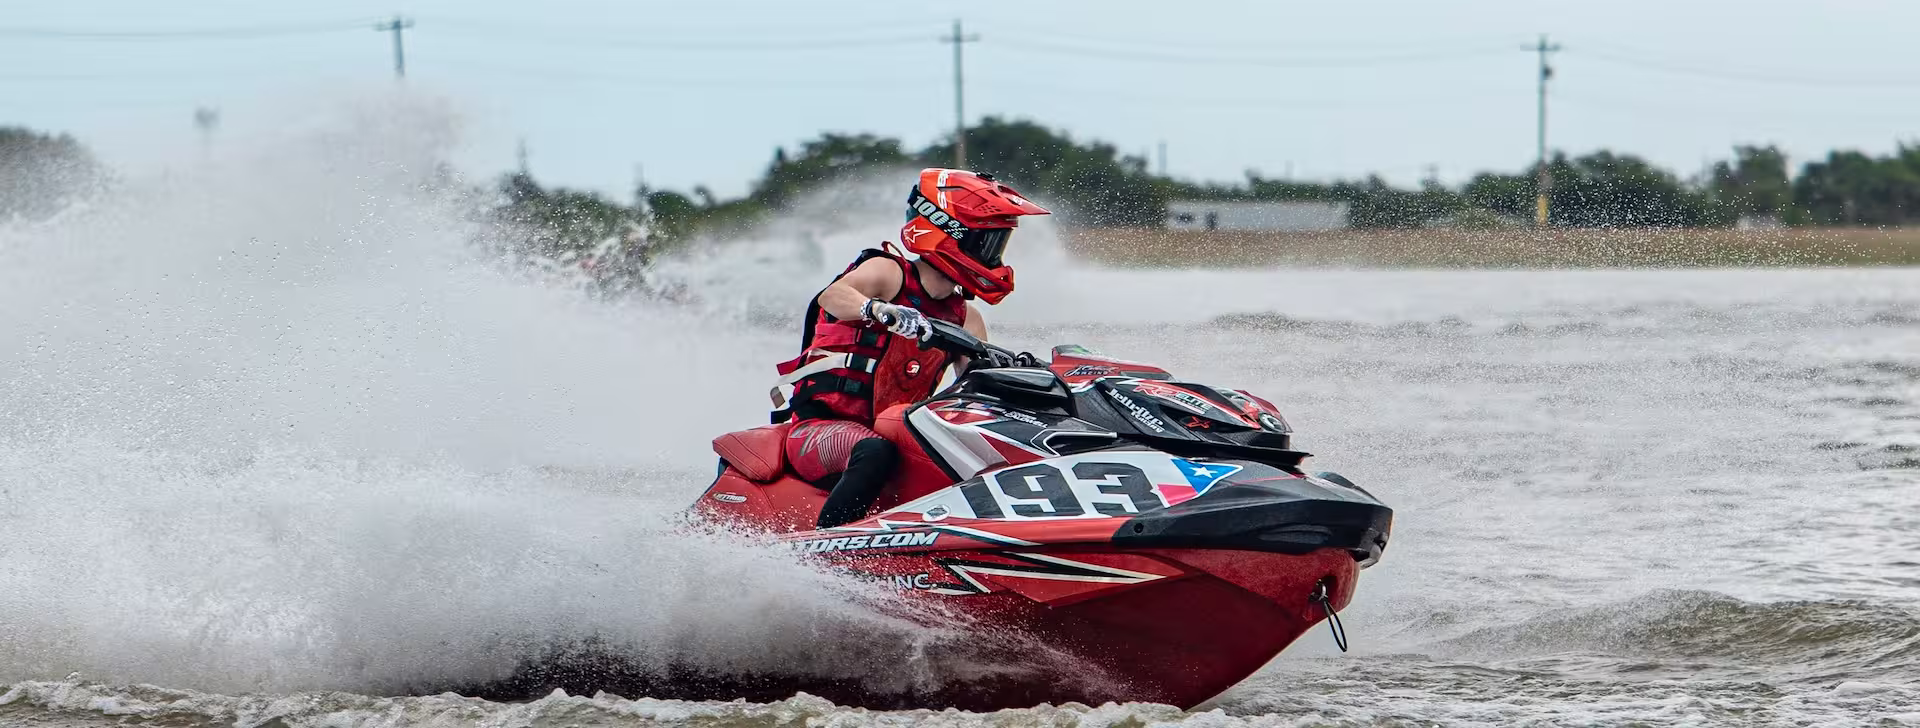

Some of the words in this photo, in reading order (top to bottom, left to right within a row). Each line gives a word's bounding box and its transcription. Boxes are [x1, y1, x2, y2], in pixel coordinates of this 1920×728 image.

[1176, 391, 1213, 410] ELITE
[959, 461, 1164, 519] 193
[796, 532, 940, 553] TORS.COM
